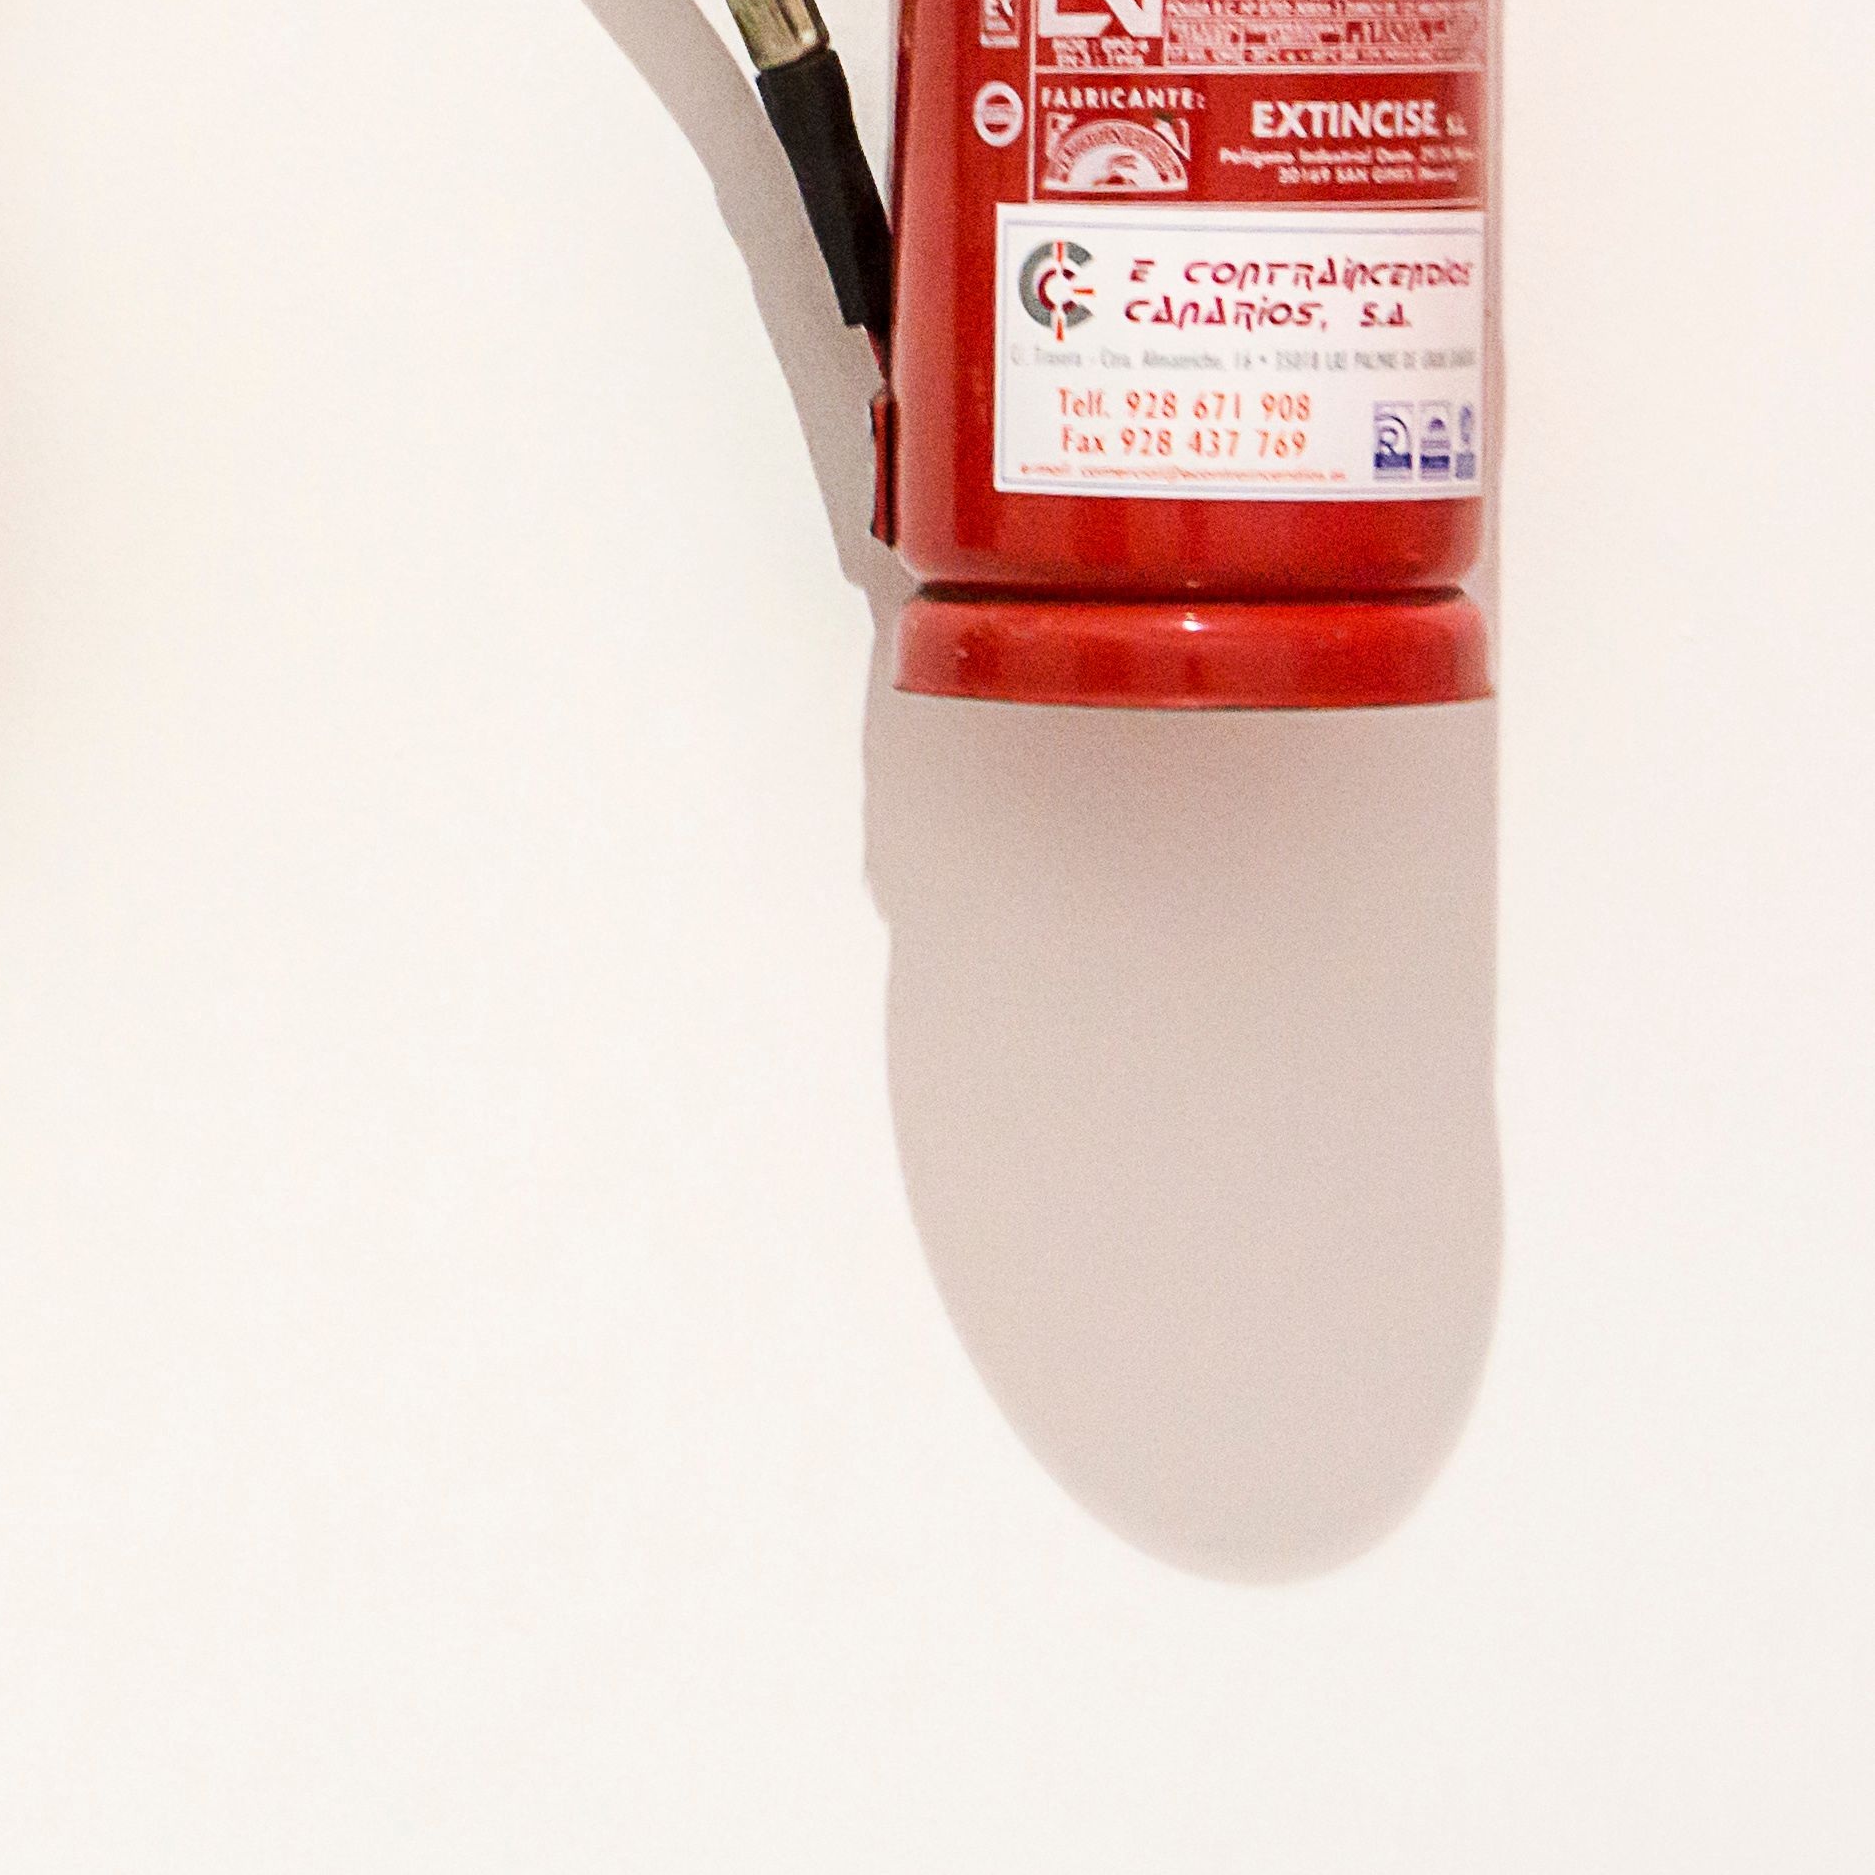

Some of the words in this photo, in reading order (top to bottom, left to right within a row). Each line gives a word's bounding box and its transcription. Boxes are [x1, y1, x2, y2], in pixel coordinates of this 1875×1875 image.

[1040, 87, 1206, 111] FABRICANTE:
[1130, 258, 1154, 285] E
[1056, 388, 1109, 420] Telf.
[1125, 389, 1178, 420] 928
[1192, 389, 1242, 420] 671
[1260, 390, 1312, 422] 908
[1061, 428, 1106, 455] Fax
[1120, 428, 1173, 456] 928
[1188, 428, 1241, 457] 437
[1257, 428, 1308, 458] 769
